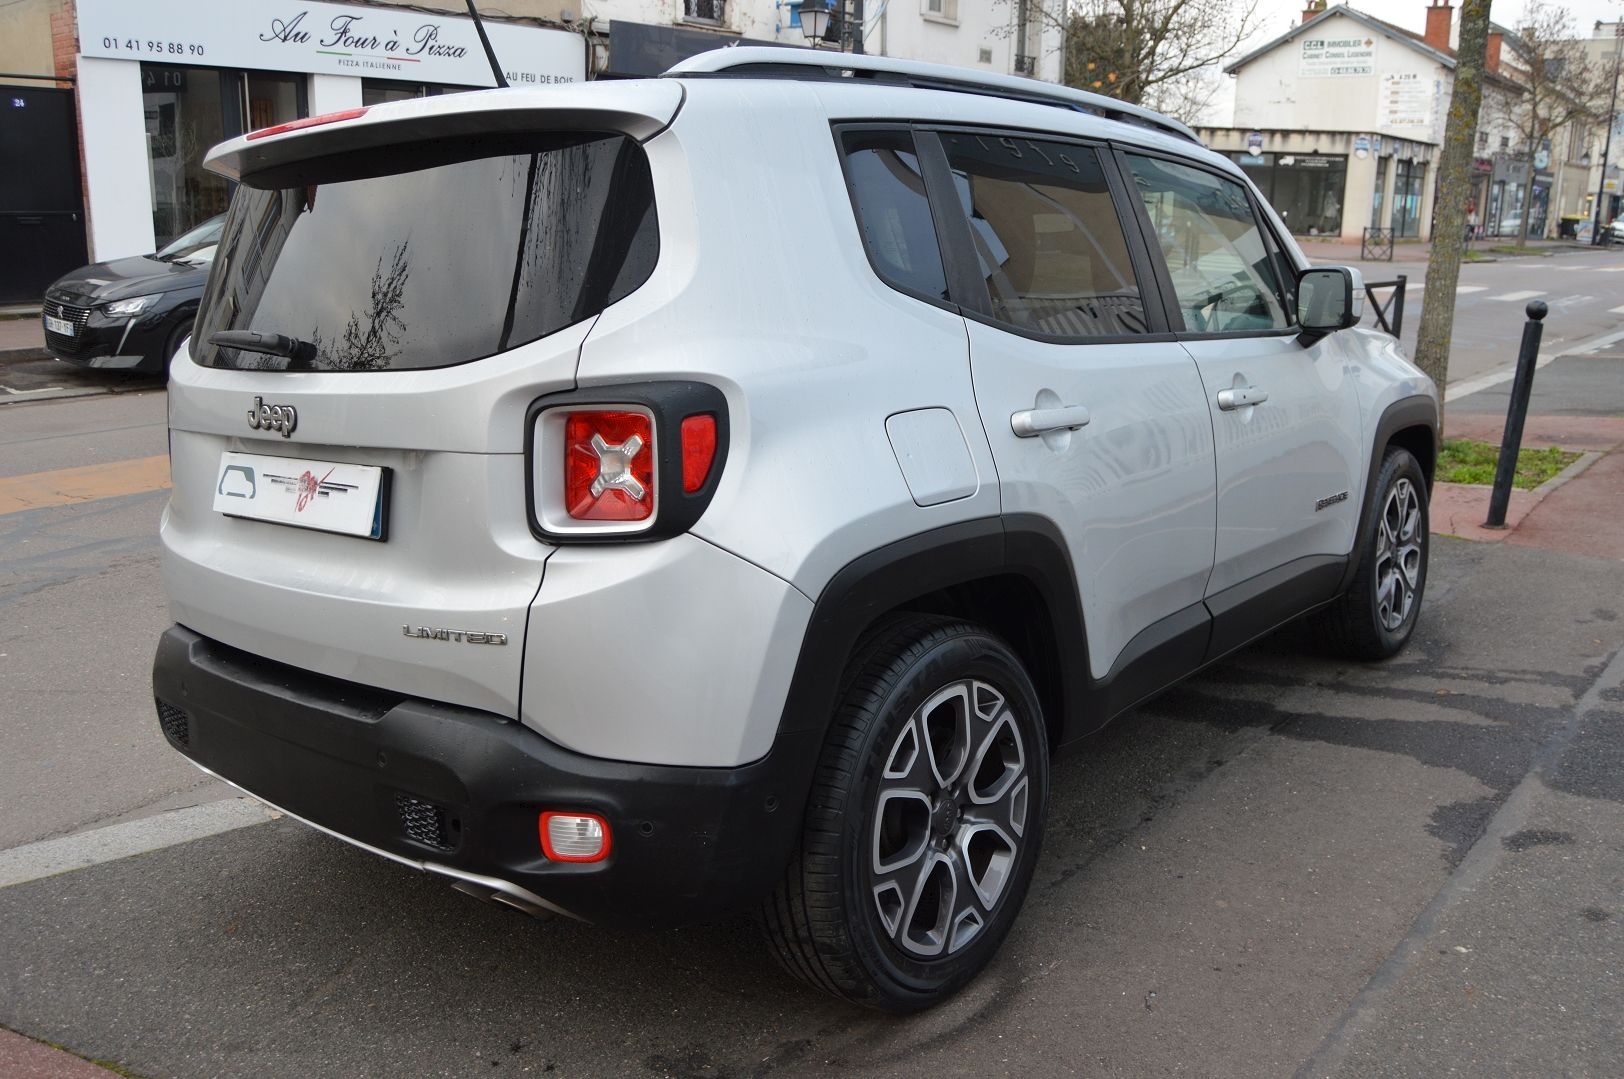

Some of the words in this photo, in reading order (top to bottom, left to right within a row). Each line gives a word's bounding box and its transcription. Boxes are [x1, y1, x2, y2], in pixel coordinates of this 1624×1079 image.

[259, 11, 311, 43] Au
[319, 15, 381, 49] Four
[384, 29, 400, 51] à
[405, 24, 467, 58] Pizza
[103, 37, 119, 49] 01
[125, 39, 140, 51] 41
[147, 41, 163, 53] 95
[168, 42, 184, 55] 88
[189, 44, 204, 56] 90
[338, 59, 360, 68] PIZZA
[362, 61, 401, 71] ITALIENNE
[505, 72, 518, 81] AU
[520, 72, 536, 82] FEU
[540, 74, 551, 84] DE
[247, 396, 297, 438] Jeep
[402, 624, 508, 645] LIMITED
